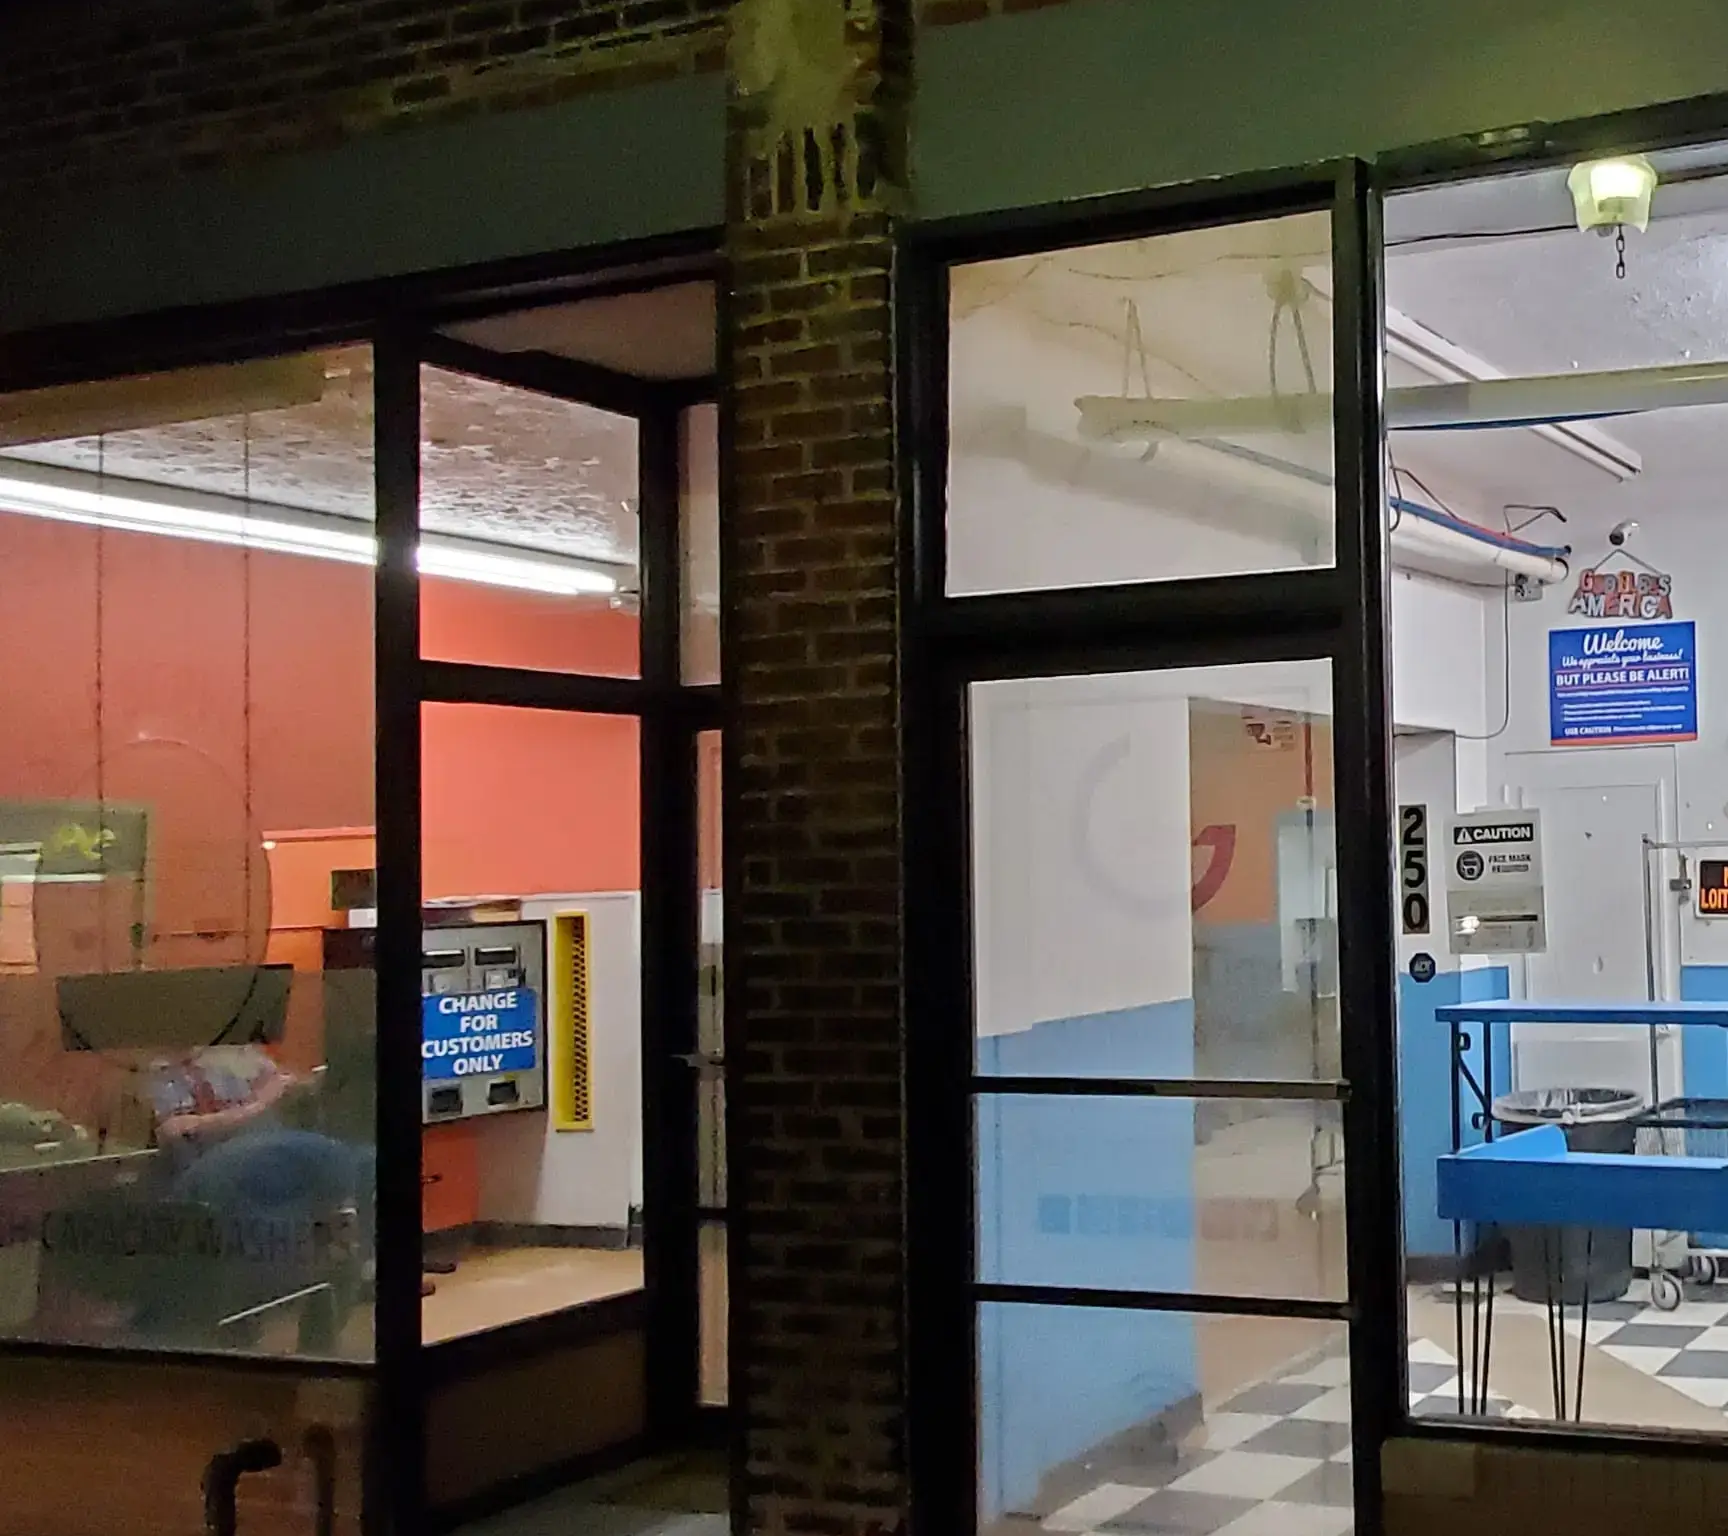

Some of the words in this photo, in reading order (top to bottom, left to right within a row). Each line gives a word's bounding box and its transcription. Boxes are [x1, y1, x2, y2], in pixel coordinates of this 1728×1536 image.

[1583, 629, 1664, 655] Welcome
[1556, 673, 1580, 686] BUT
[1582, 670, 1627, 684] PLEASE
[1629, 669, 1644, 683] BE
[1473, 826, 1531, 841] CAUTION
[1402, 807, 1430, 930] 250
[438, 991, 518, 1014] CHANGE
[460, 1014, 498, 1033] FOR
[421, 1030, 533, 1058] CUSTOMERS
[453, 1054, 503, 1075] ONLY
